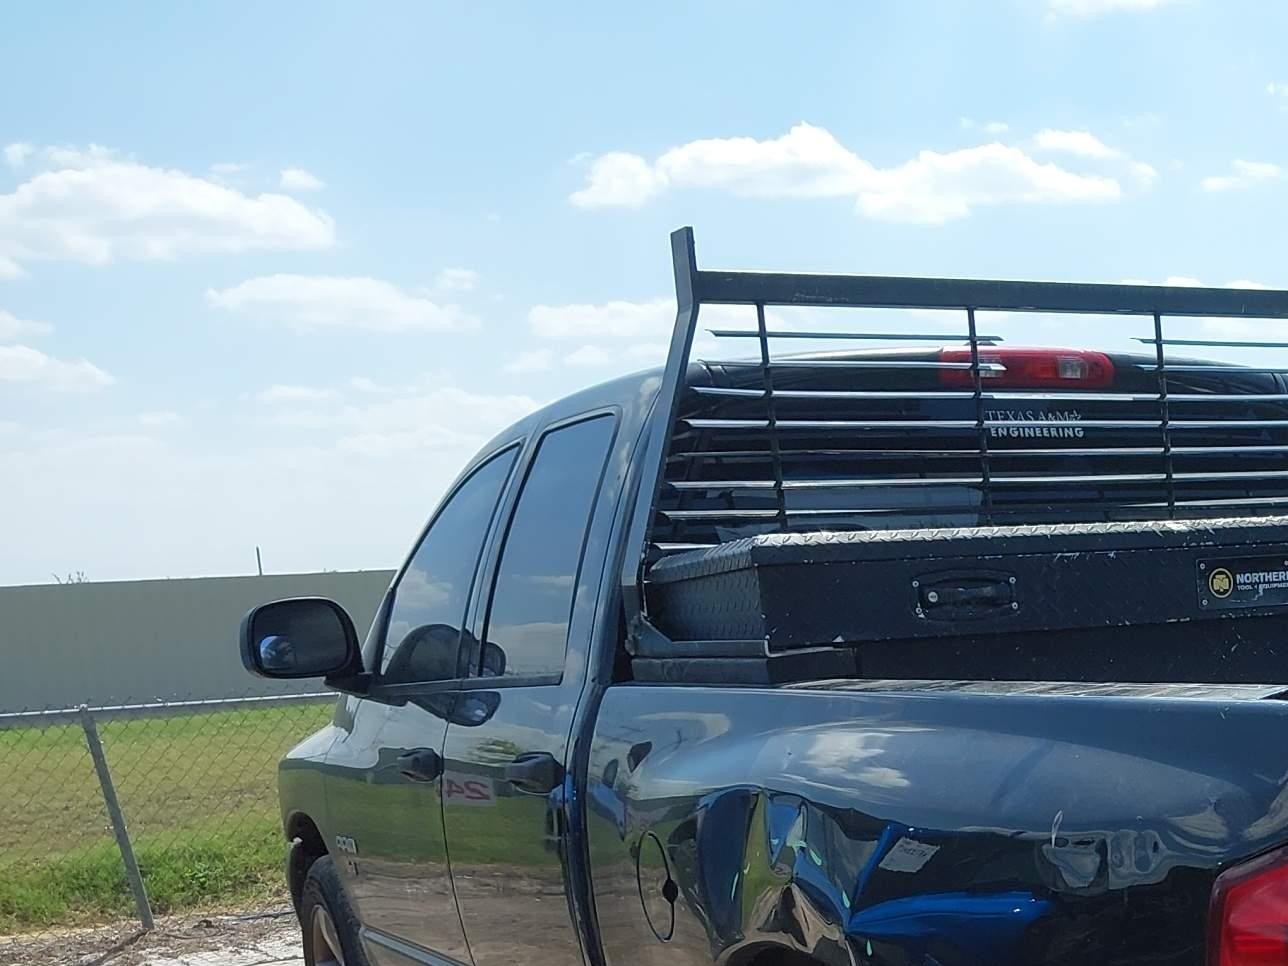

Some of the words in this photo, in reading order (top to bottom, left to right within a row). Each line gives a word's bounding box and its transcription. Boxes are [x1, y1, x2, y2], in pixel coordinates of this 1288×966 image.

[985, 410, 1035, 421] TEXAS
[1040, 410, 1069, 421] A&M
[991, 427, 1085, 438] ENGINEERING
